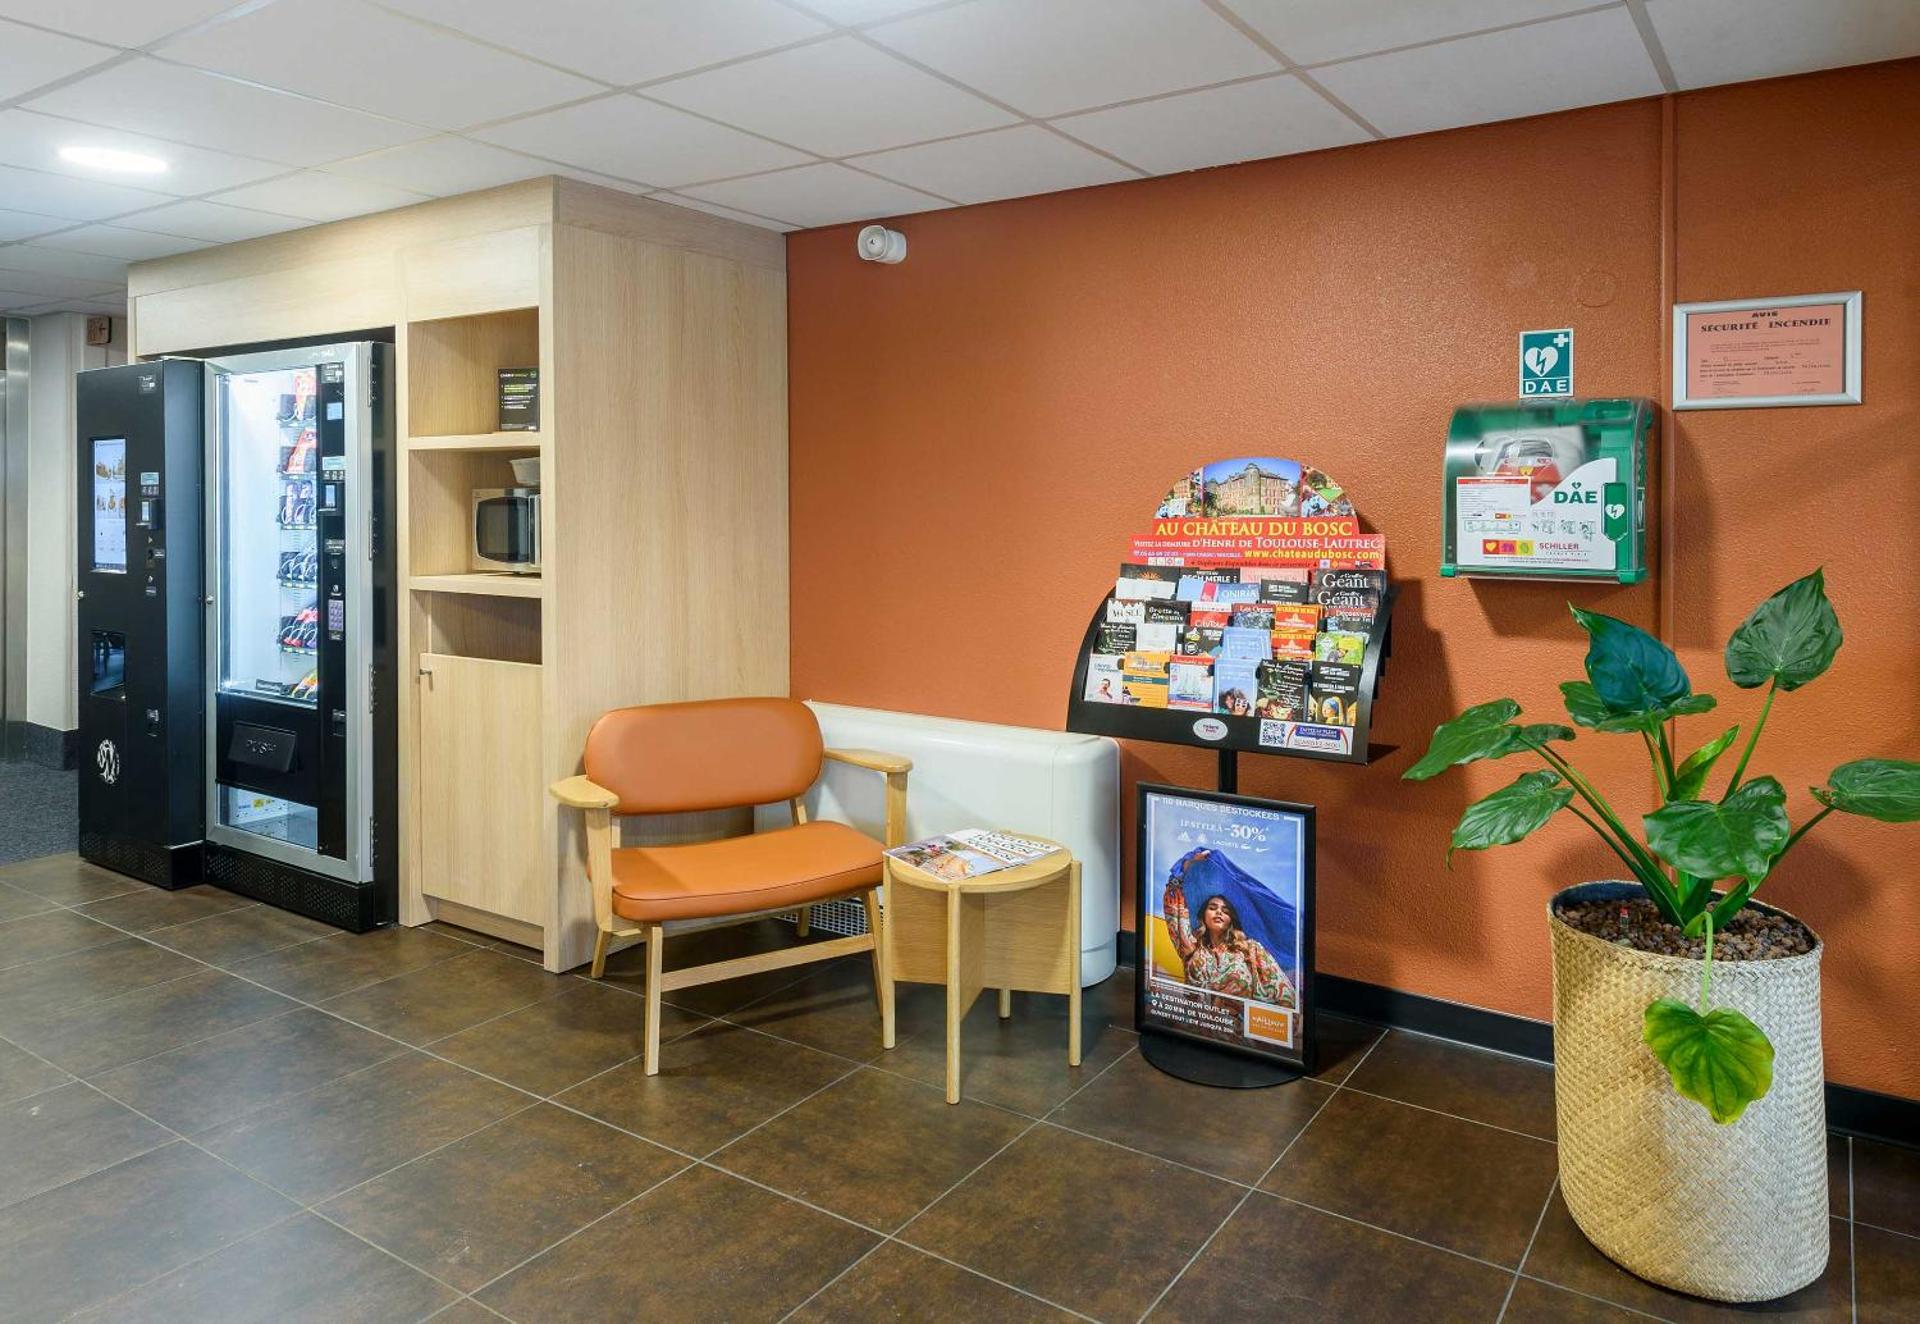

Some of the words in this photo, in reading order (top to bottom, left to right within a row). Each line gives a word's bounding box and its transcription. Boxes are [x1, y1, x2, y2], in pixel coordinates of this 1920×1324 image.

[1768, 318, 1831, 329] INCENDIE
[1525, 379, 1569, 394] DAE
[1554, 490, 1598, 504] DAE
[1156, 522, 1179, 535] AU
[1183, 519, 1262, 535] CHÂTEAU
[1268, 522, 1297, 536] DU
[1303, 522, 1353, 536] BOSC
[1539, 542, 1580, 550] SCHILLER
[1244, 549, 1379, 559] www.chateaudubosc.com
[1322, 573, 1369, 588] Géant
[1317, 591, 1364, 606] Géant
[1175, 798, 1217, 812] MARQUES
[1161, 994, 1203, 1009] DESTINATION
[1203, 1003, 1230, 1015] OUTLET
[1187, 1008, 1197, 1016] DE
[1198, 1011, 1234, 1025] TOULOUSE
